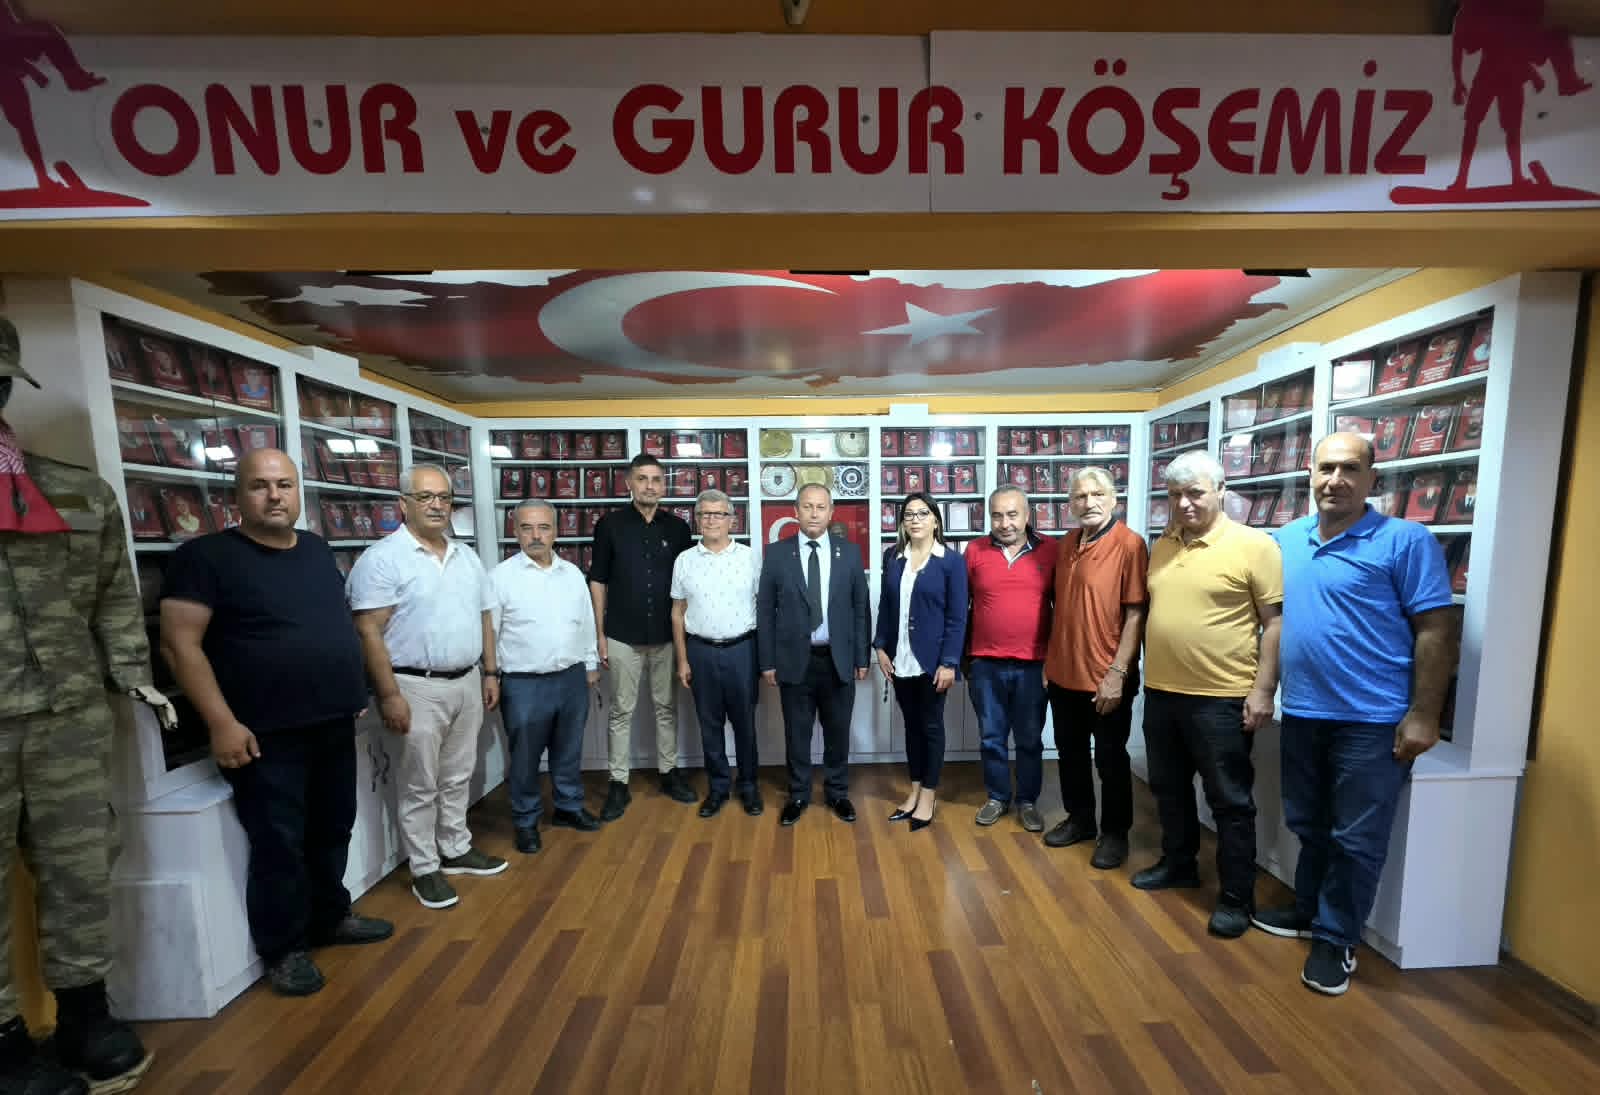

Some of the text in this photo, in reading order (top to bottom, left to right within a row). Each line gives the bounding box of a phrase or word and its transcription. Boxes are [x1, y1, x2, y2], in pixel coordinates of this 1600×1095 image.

[111, 58, 1434, 201] ONUR ve GURUR KÖŞEMİZ
